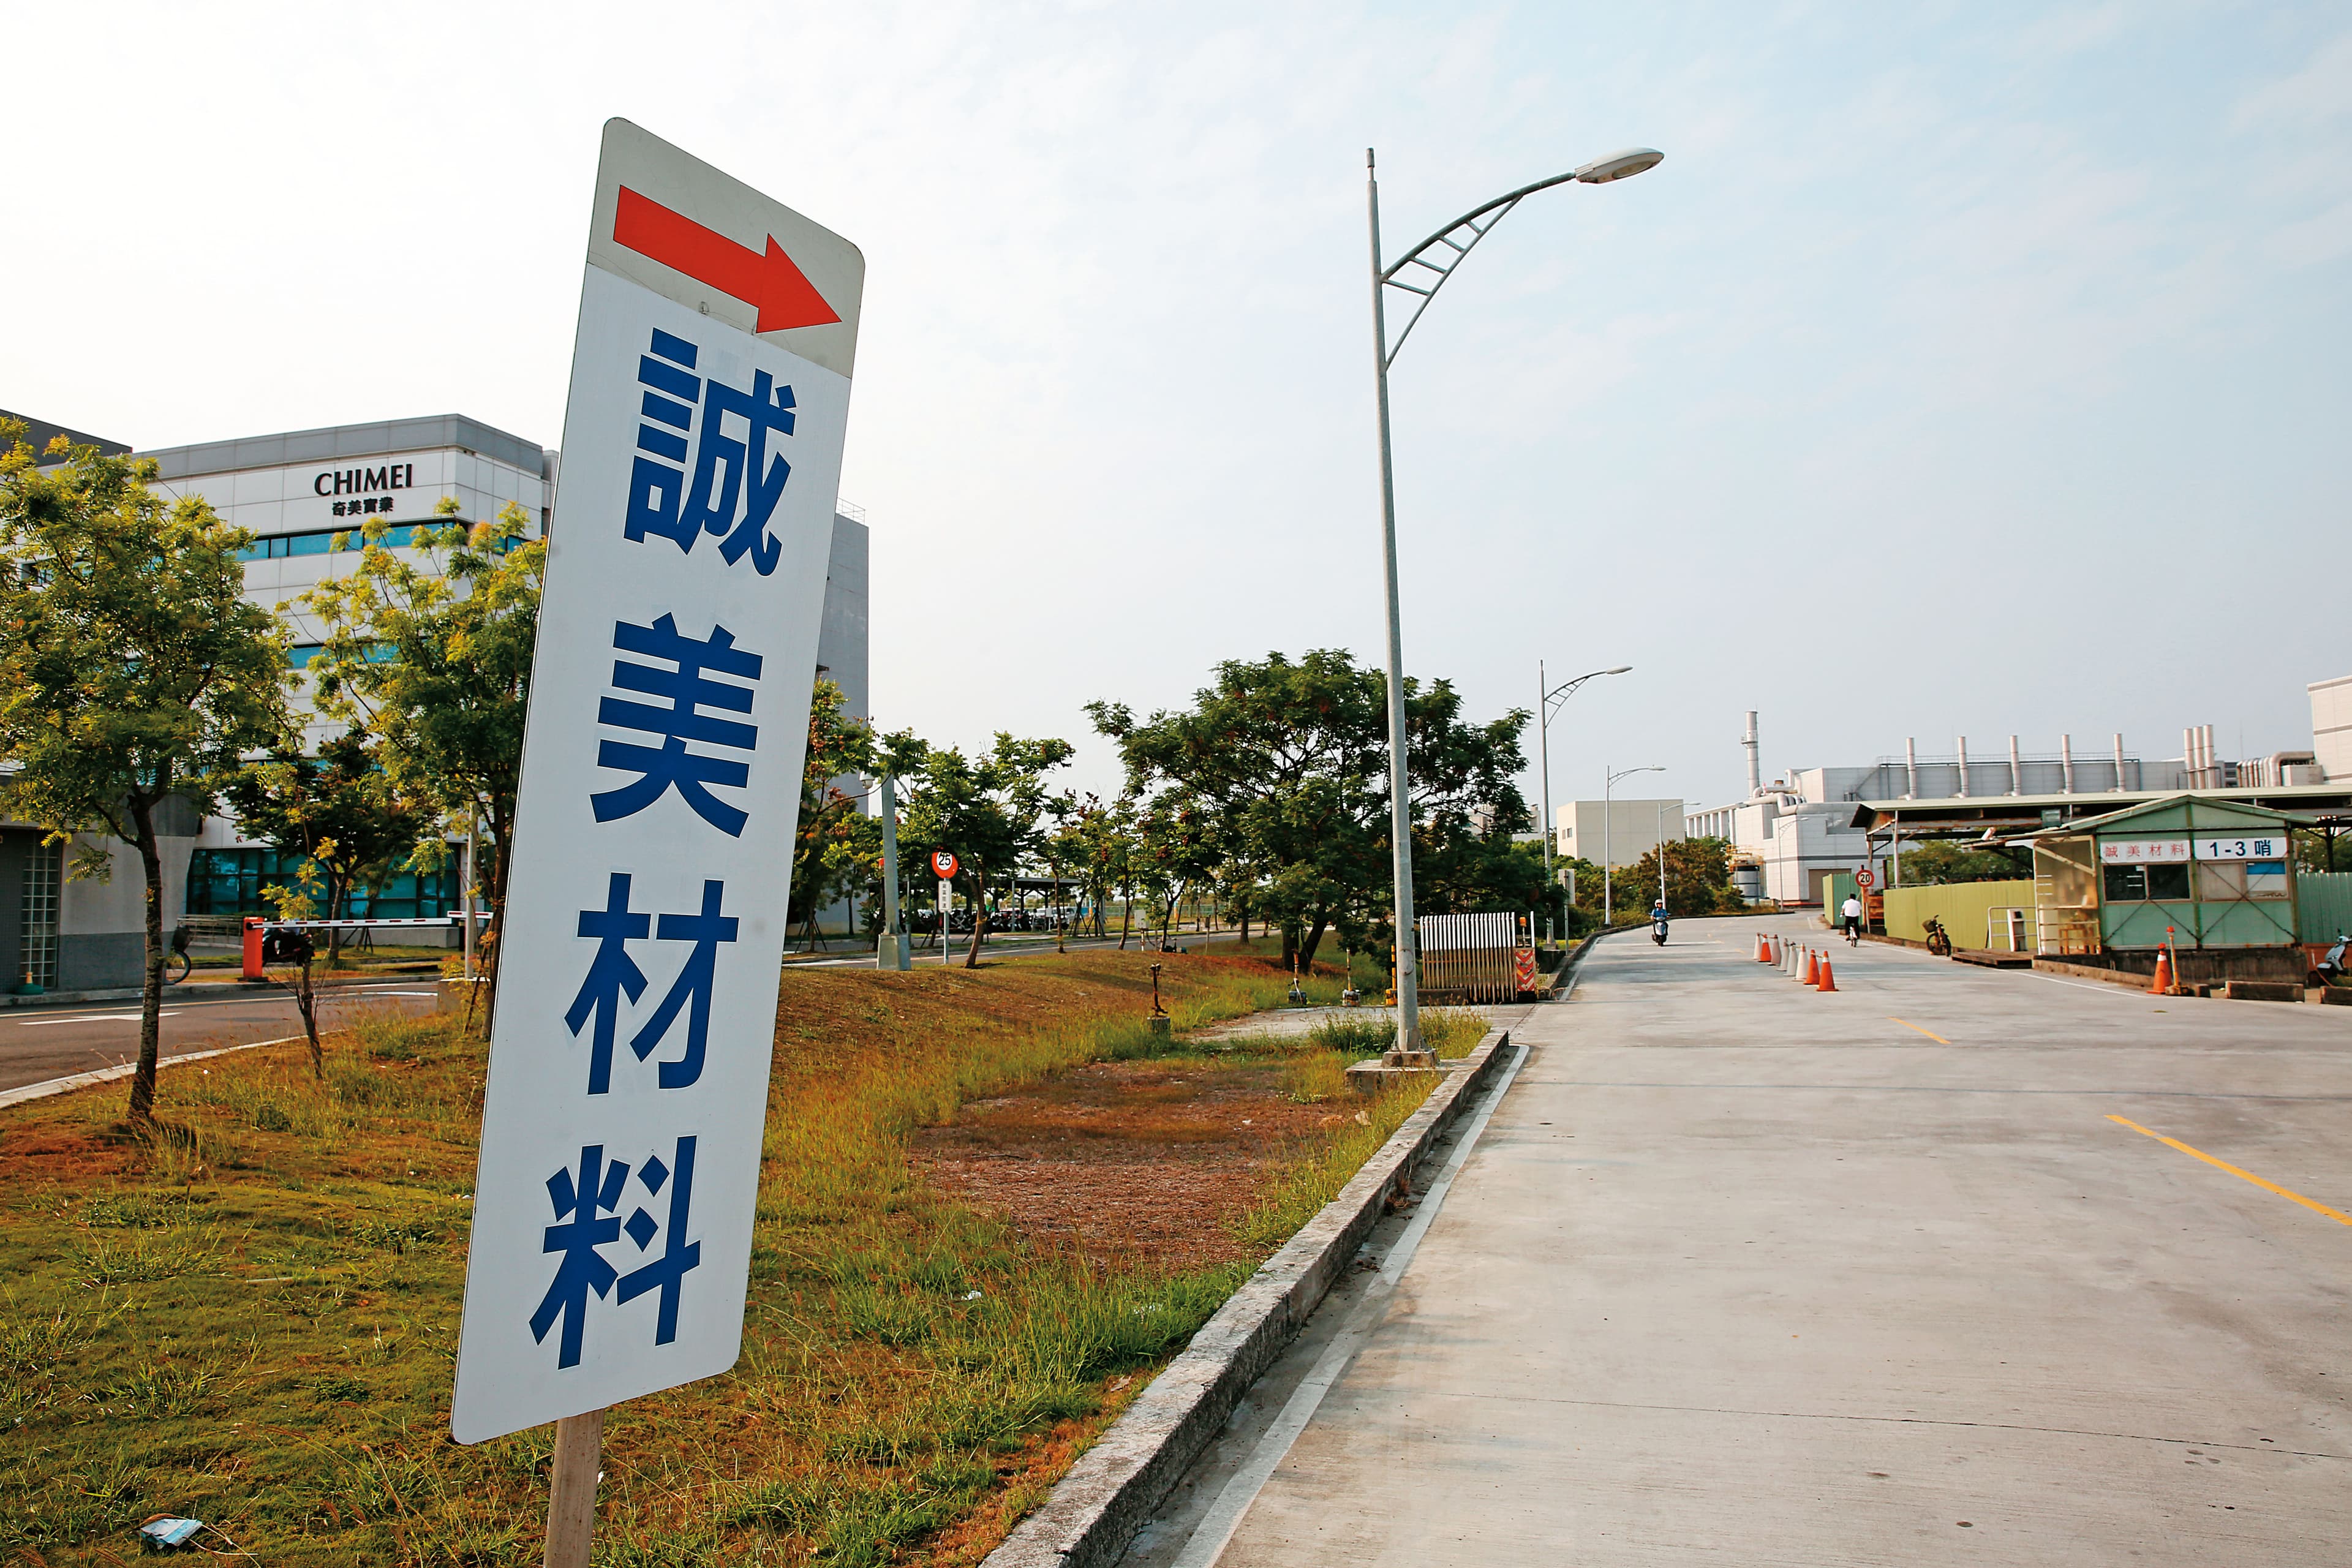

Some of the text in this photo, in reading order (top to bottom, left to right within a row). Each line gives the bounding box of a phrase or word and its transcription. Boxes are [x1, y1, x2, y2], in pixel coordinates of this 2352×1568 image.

[314, 464, 412, 496] CHIMEI
[332, 497, 393, 516] 奇美實業
[530, 328, 796, 1368] 誠美材料
[2103, 843, 2184, 858] 誠美材料
[938, 854, 951, 866] 25
[1860, 874, 1870, 883] 20
